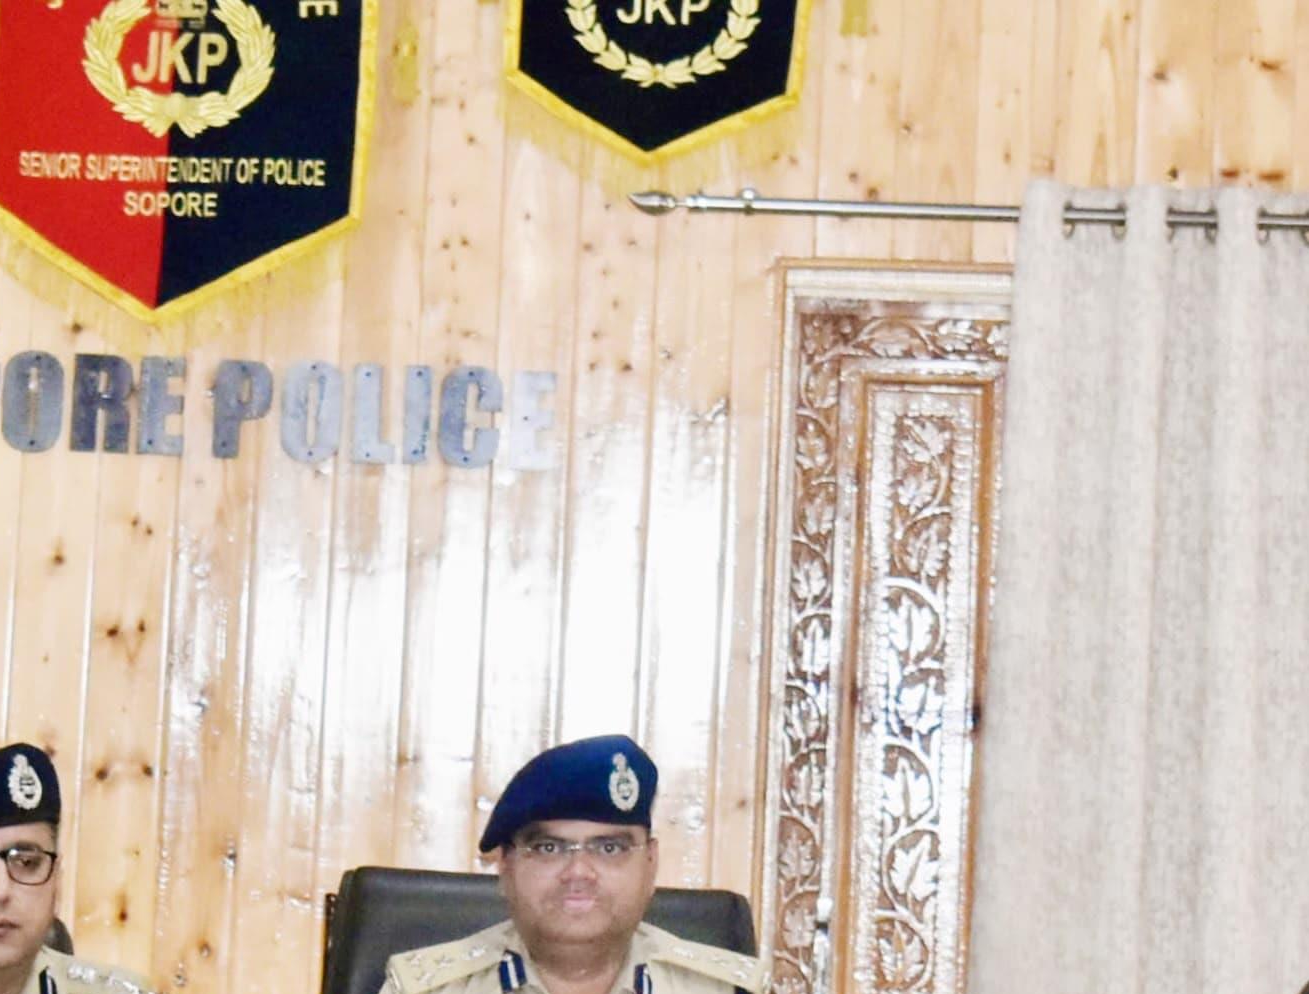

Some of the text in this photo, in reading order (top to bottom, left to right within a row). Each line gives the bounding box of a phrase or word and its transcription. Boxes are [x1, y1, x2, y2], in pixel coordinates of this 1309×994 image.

[131, 31, 229, 85] JKP
[19, 151, 326, 187] SENIOR SUPERINTENDENT OF POLICE
[124, 191, 218, 218] SOPORE
[211, 359, 559, 471] POLICE
